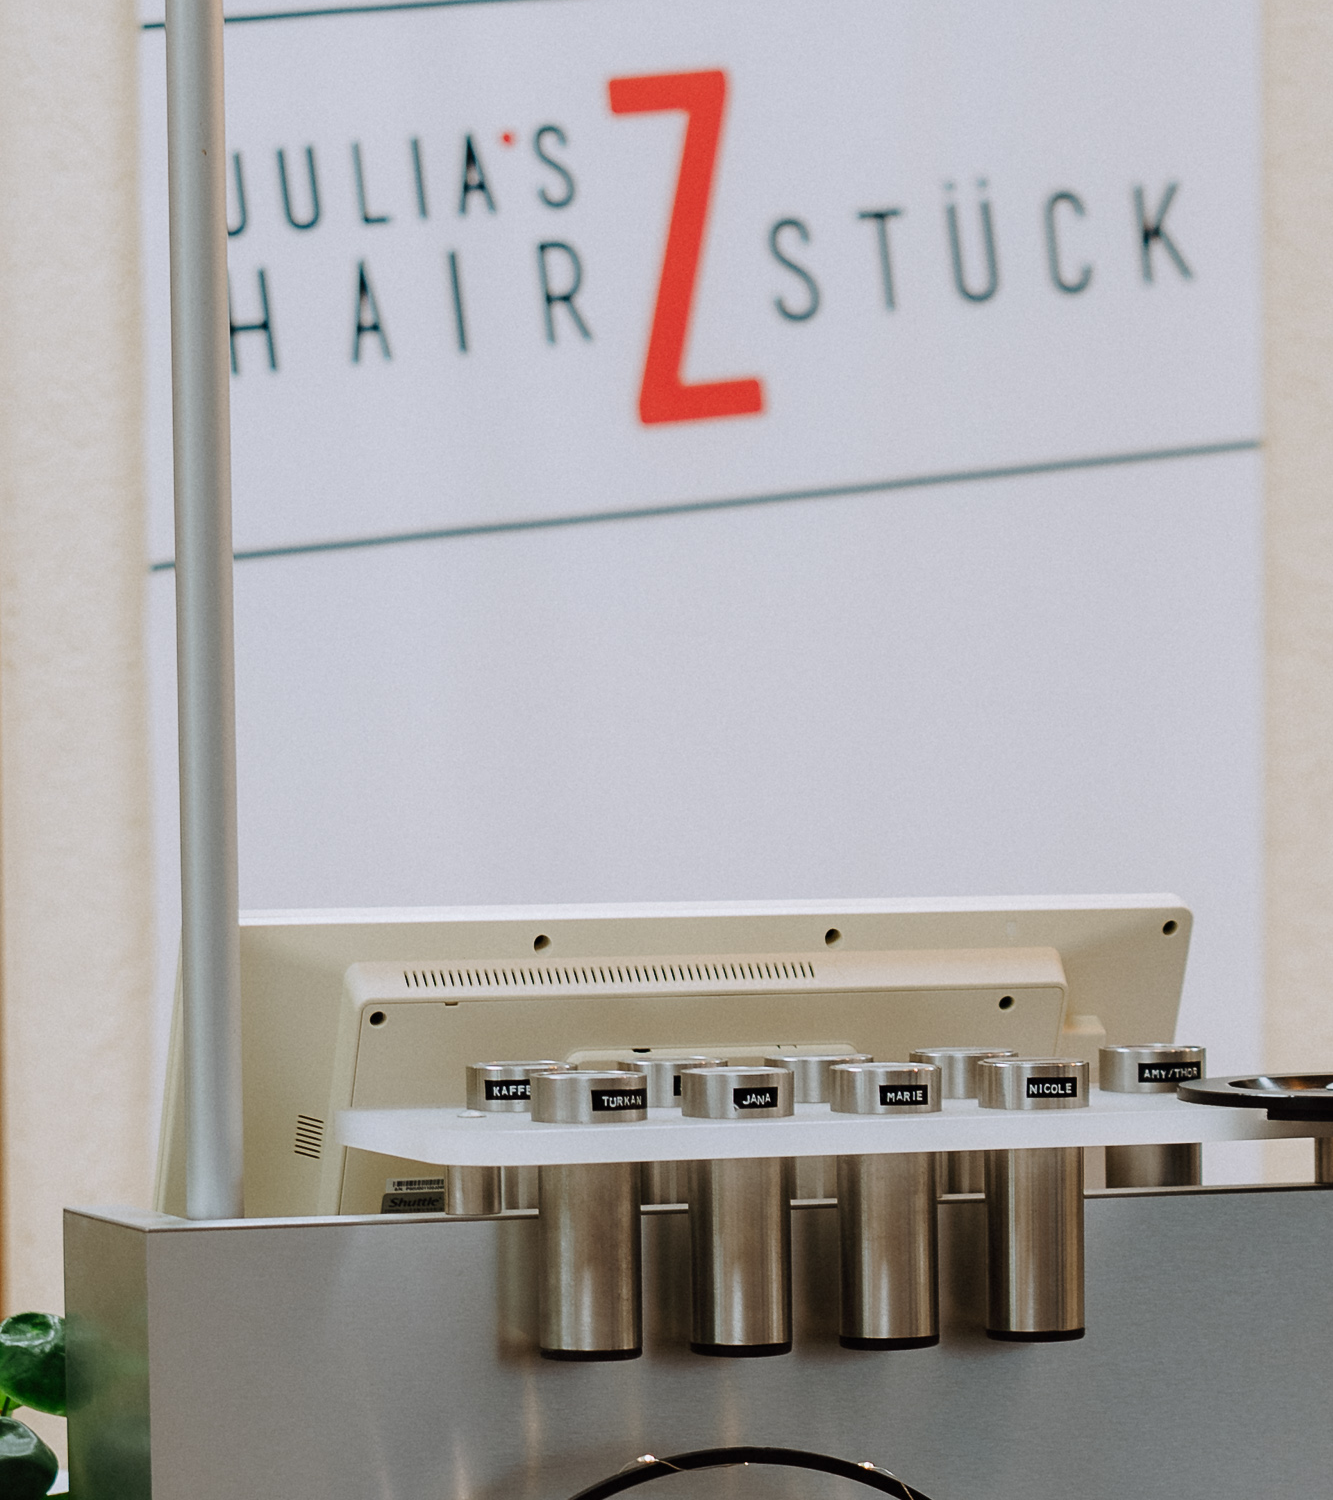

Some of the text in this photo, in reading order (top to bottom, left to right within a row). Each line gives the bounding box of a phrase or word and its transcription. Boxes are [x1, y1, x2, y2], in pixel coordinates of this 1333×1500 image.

[228, 68, 1196, 426] HAIR Z STÜCK
[1143, 1067, 1198, 1079] AMY/THOR
[1029, 1082, 1072, 1095] NICOLE
[742, 1092, 771, 1106] JANA
[886, 1090, 923, 1103] MARIE
[388, 1197, 439, 1208] Shuttle
